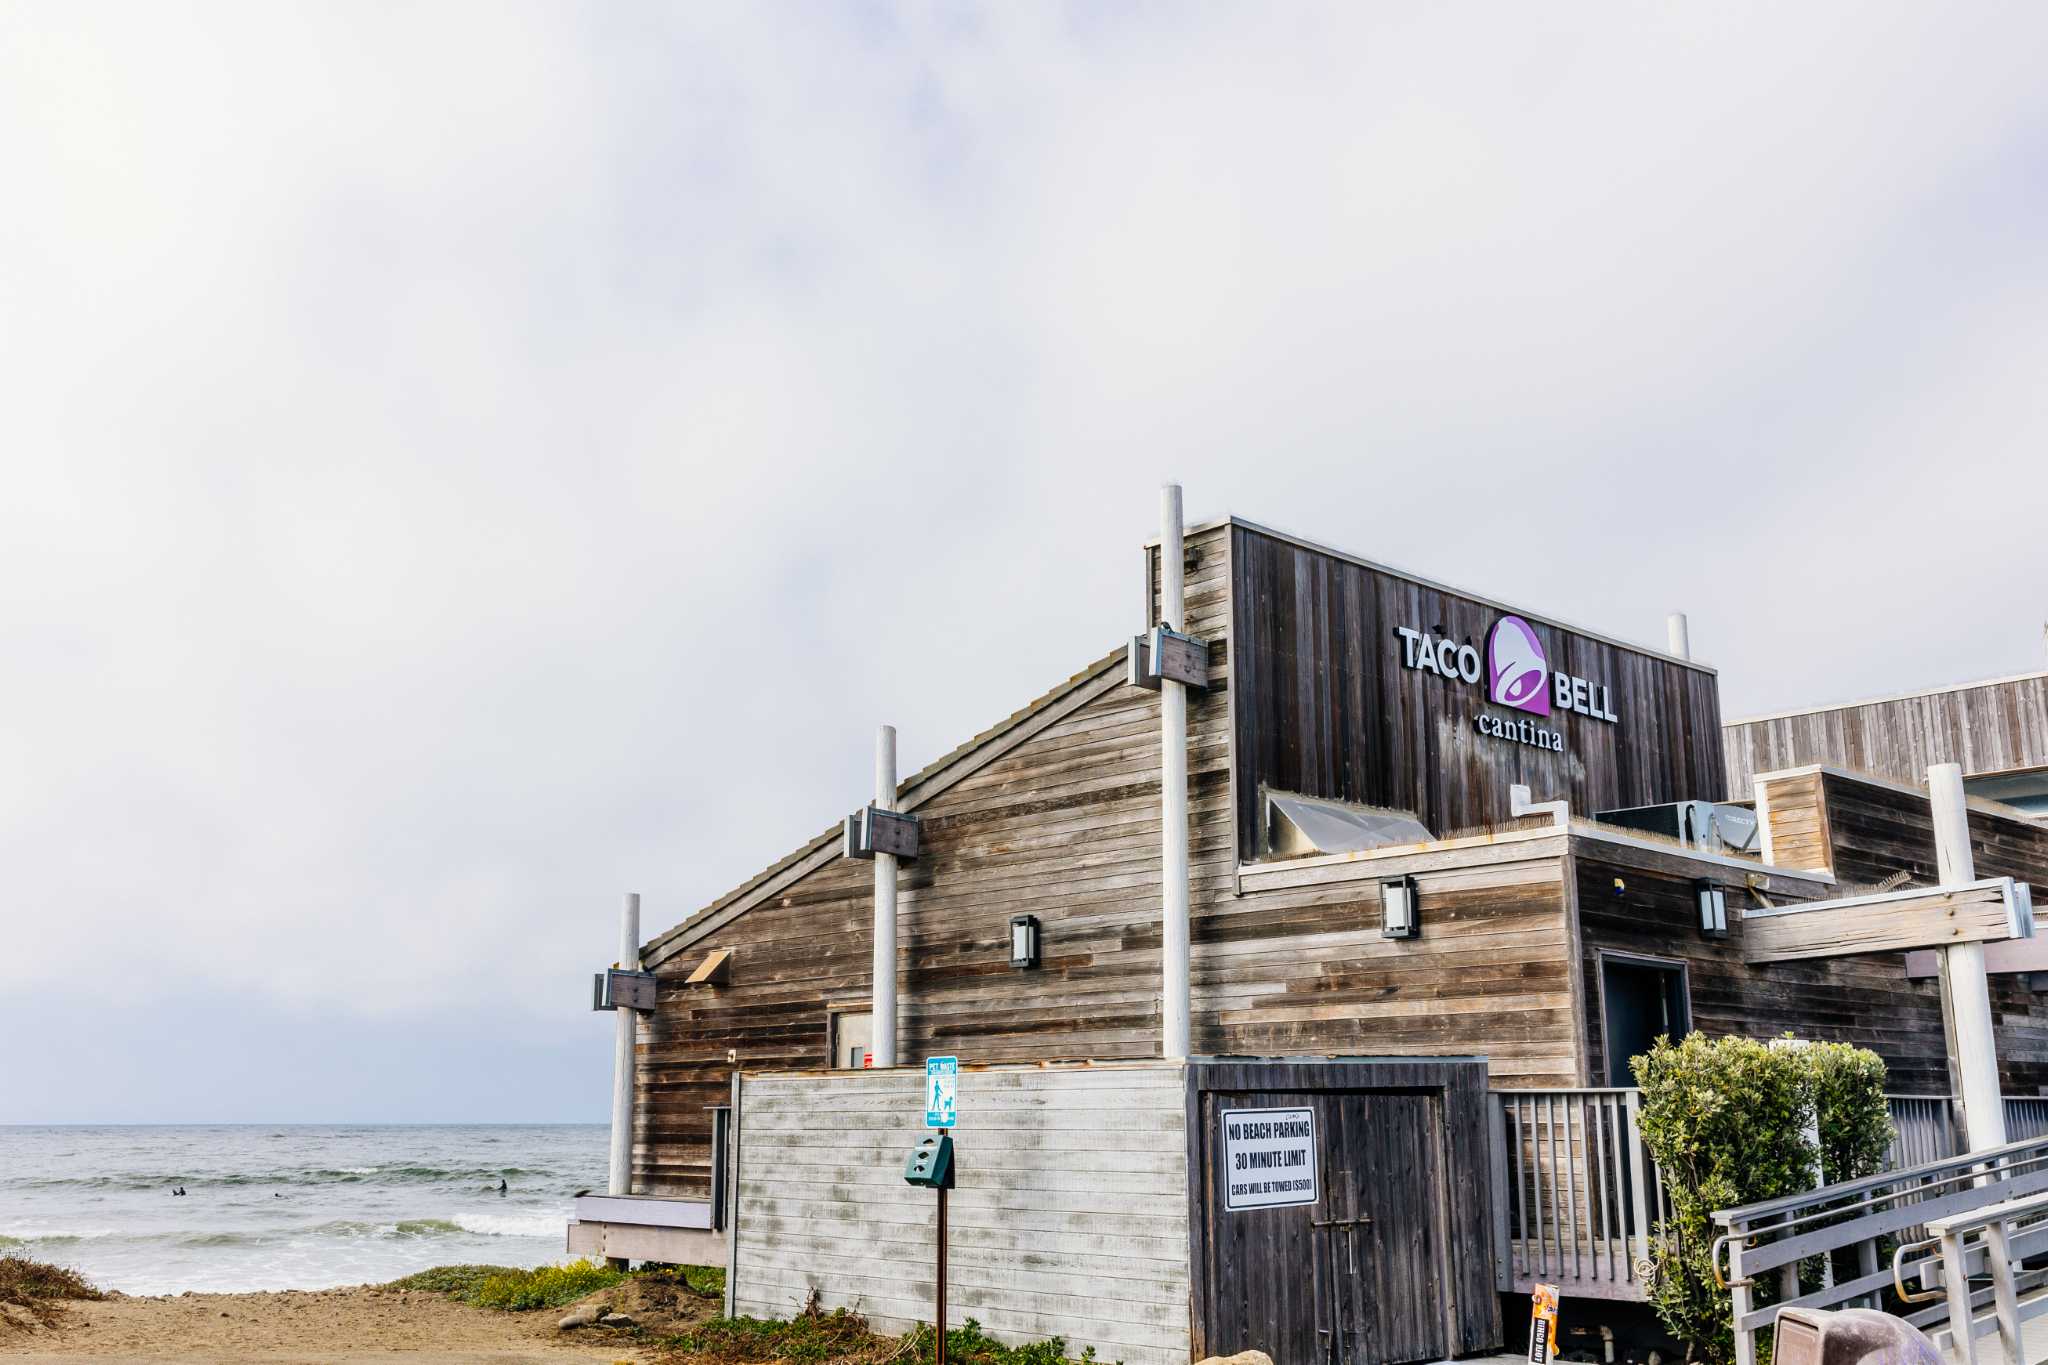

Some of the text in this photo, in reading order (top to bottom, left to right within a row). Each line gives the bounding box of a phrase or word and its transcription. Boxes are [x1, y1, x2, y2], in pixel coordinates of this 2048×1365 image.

[1398, 626, 1618, 723] TACO BELL
[1479, 714, 1564, 752] cantina
[1229, 1120, 1310, 1140] NO BEACH PARKING
[1235, 1149, 1306, 1170] 30 MINUTE LIMIT
[1232, 1183, 1248, 1195] CARS
[1248, 1182, 1263, 1194] WILL
[1264, 1181, 1271, 1193] BE
[1272, 1180, 1292, 1192] TOWED
